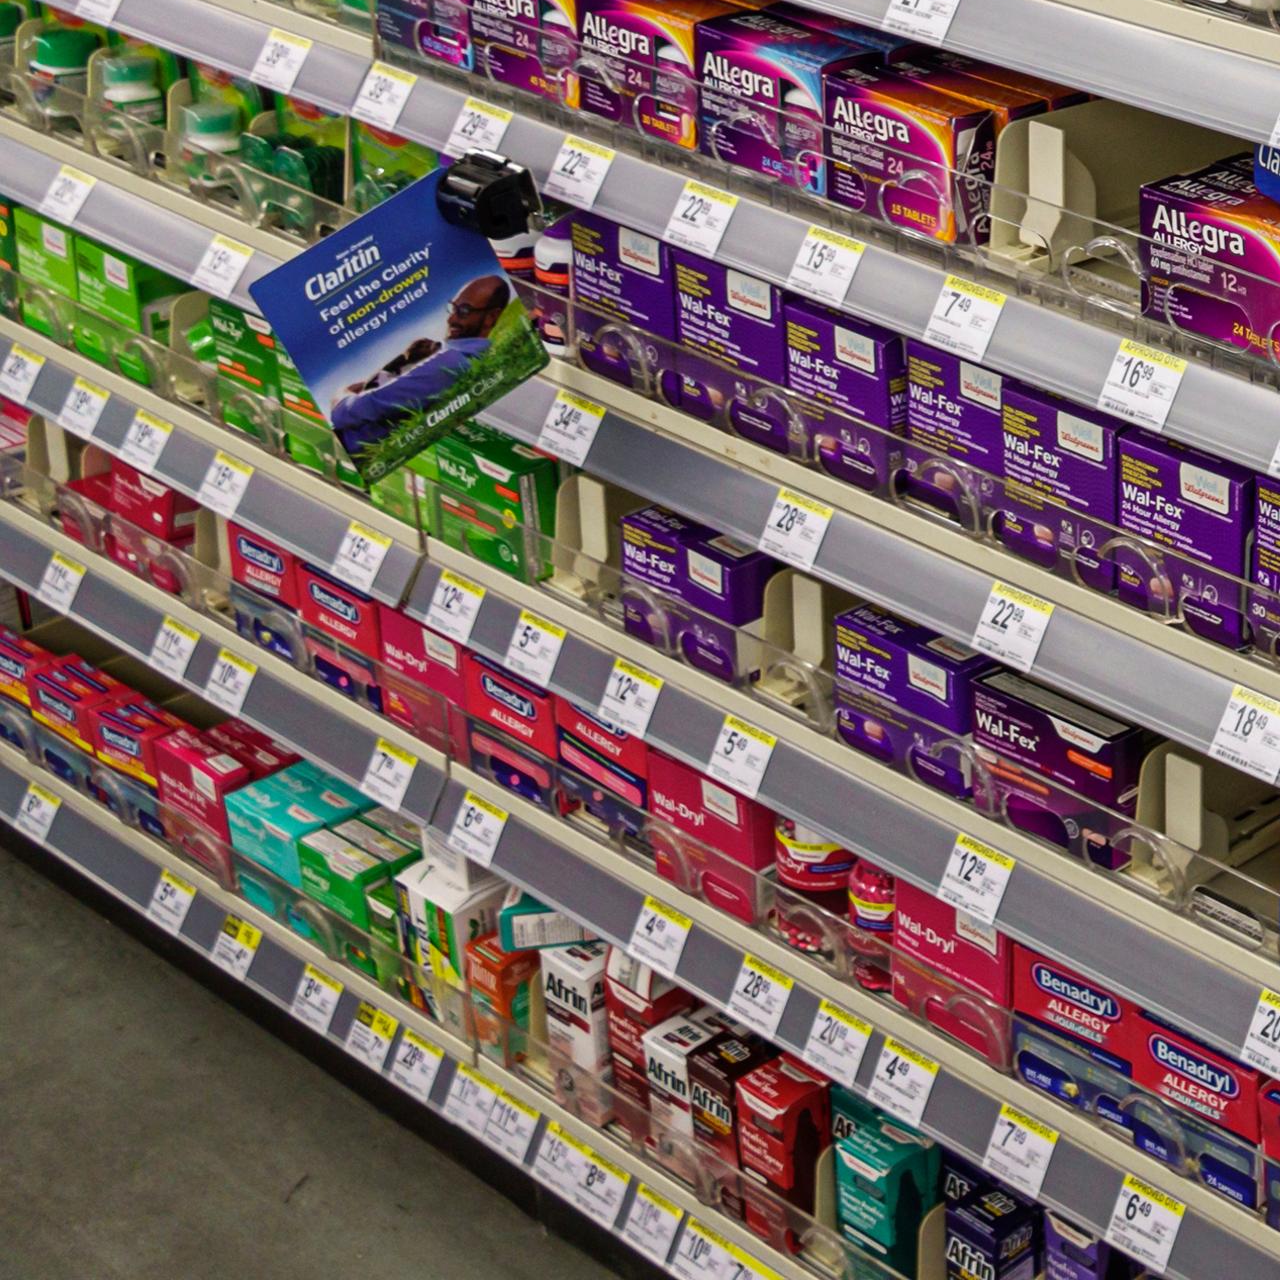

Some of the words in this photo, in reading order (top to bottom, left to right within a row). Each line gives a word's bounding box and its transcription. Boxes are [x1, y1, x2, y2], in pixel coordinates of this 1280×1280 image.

[704, 52, 775, 98] Allegra
[834, 97, 910, 143] Allegra
[1152, 204, 1245, 255] Allegra
[305, 245, 381, 300] Claritin
[319, 298, 354, 322] Feel
[356, 280, 381, 300] the
[382, 246, 430, 281] Clarity
[329, 319, 345, 335] of
[347, 266, 430, 324] non-drowsy
[337, 311, 388, 349] allergy
[391, 282, 429, 314] relief
[426, 392, 470, 428] Claritin
[1122, 490, 1184, 520] Wal-Fex
[898, 913, 955, 954] Wal-Dryl
[1036, 966, 1117, 1014] Benadryl
[1047, 1000, 1110, 1034] ALLERGY
[646, 1056, 686, 1097] Afrin
